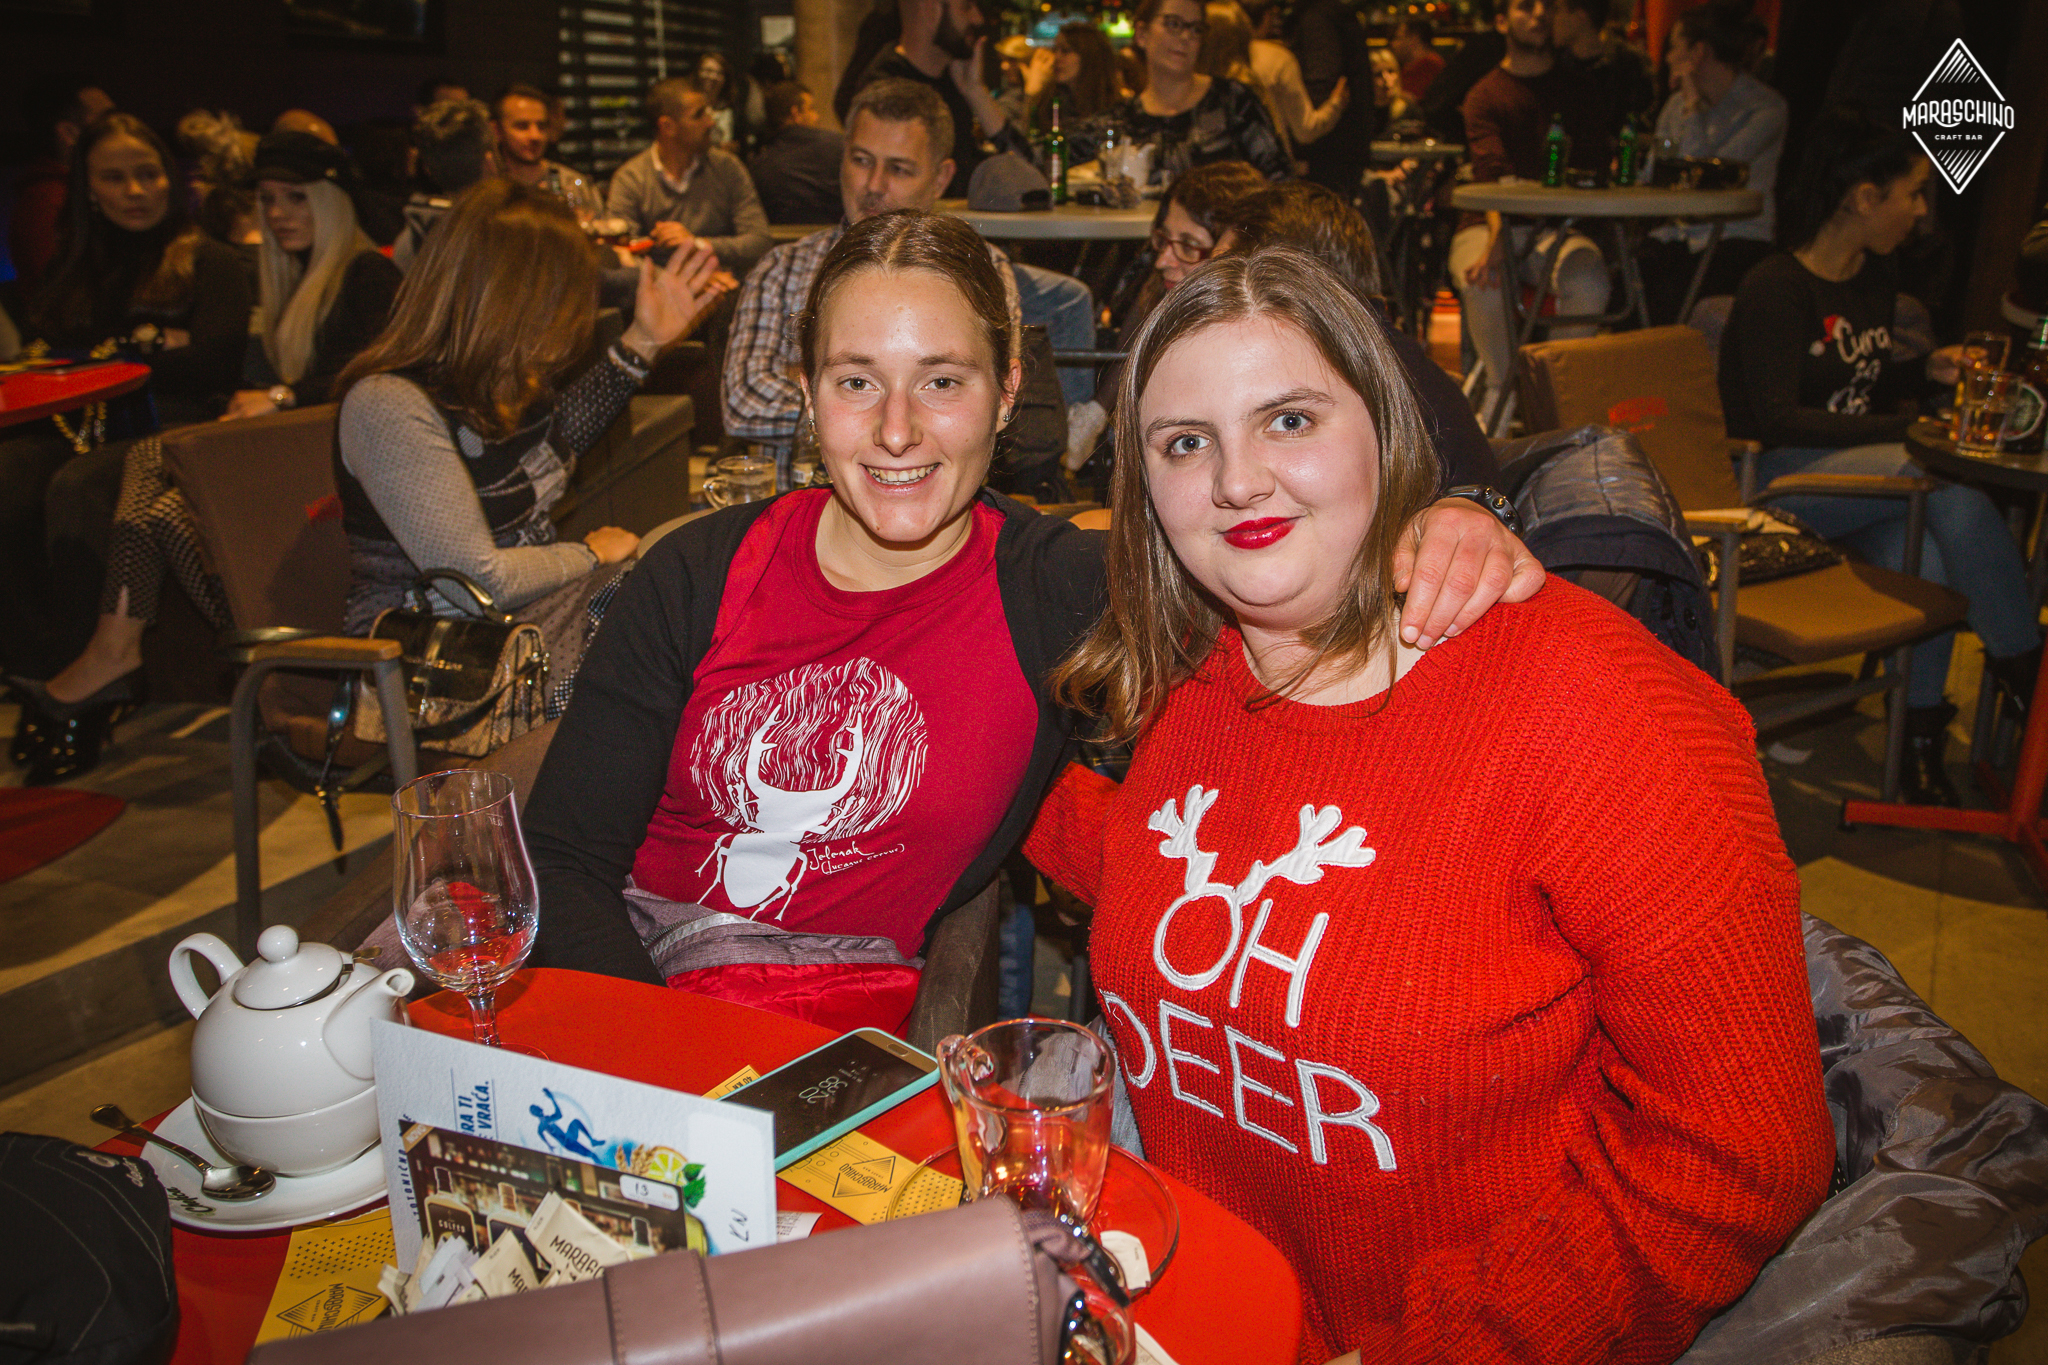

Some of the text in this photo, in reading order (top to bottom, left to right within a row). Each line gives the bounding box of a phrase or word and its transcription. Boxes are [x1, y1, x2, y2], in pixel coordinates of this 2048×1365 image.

[1153, 882, 1330, 1028] OH
[743, 1076, 753, 1088] 40
[818, 1075, 848, 1094] 38
[1099, 988, 1397, 1172] DEER
[458, 1095, 473, 1109] TI
[471, 1081, 492, 1129] VRAĆA.
[799, 1086, 829, 1104] 20
[635, 1182, 649, 1197] 13
[838, 1163, 893, 1193] MARASCHINO
[314, 1282, 344, 1334] MARASCHIN
